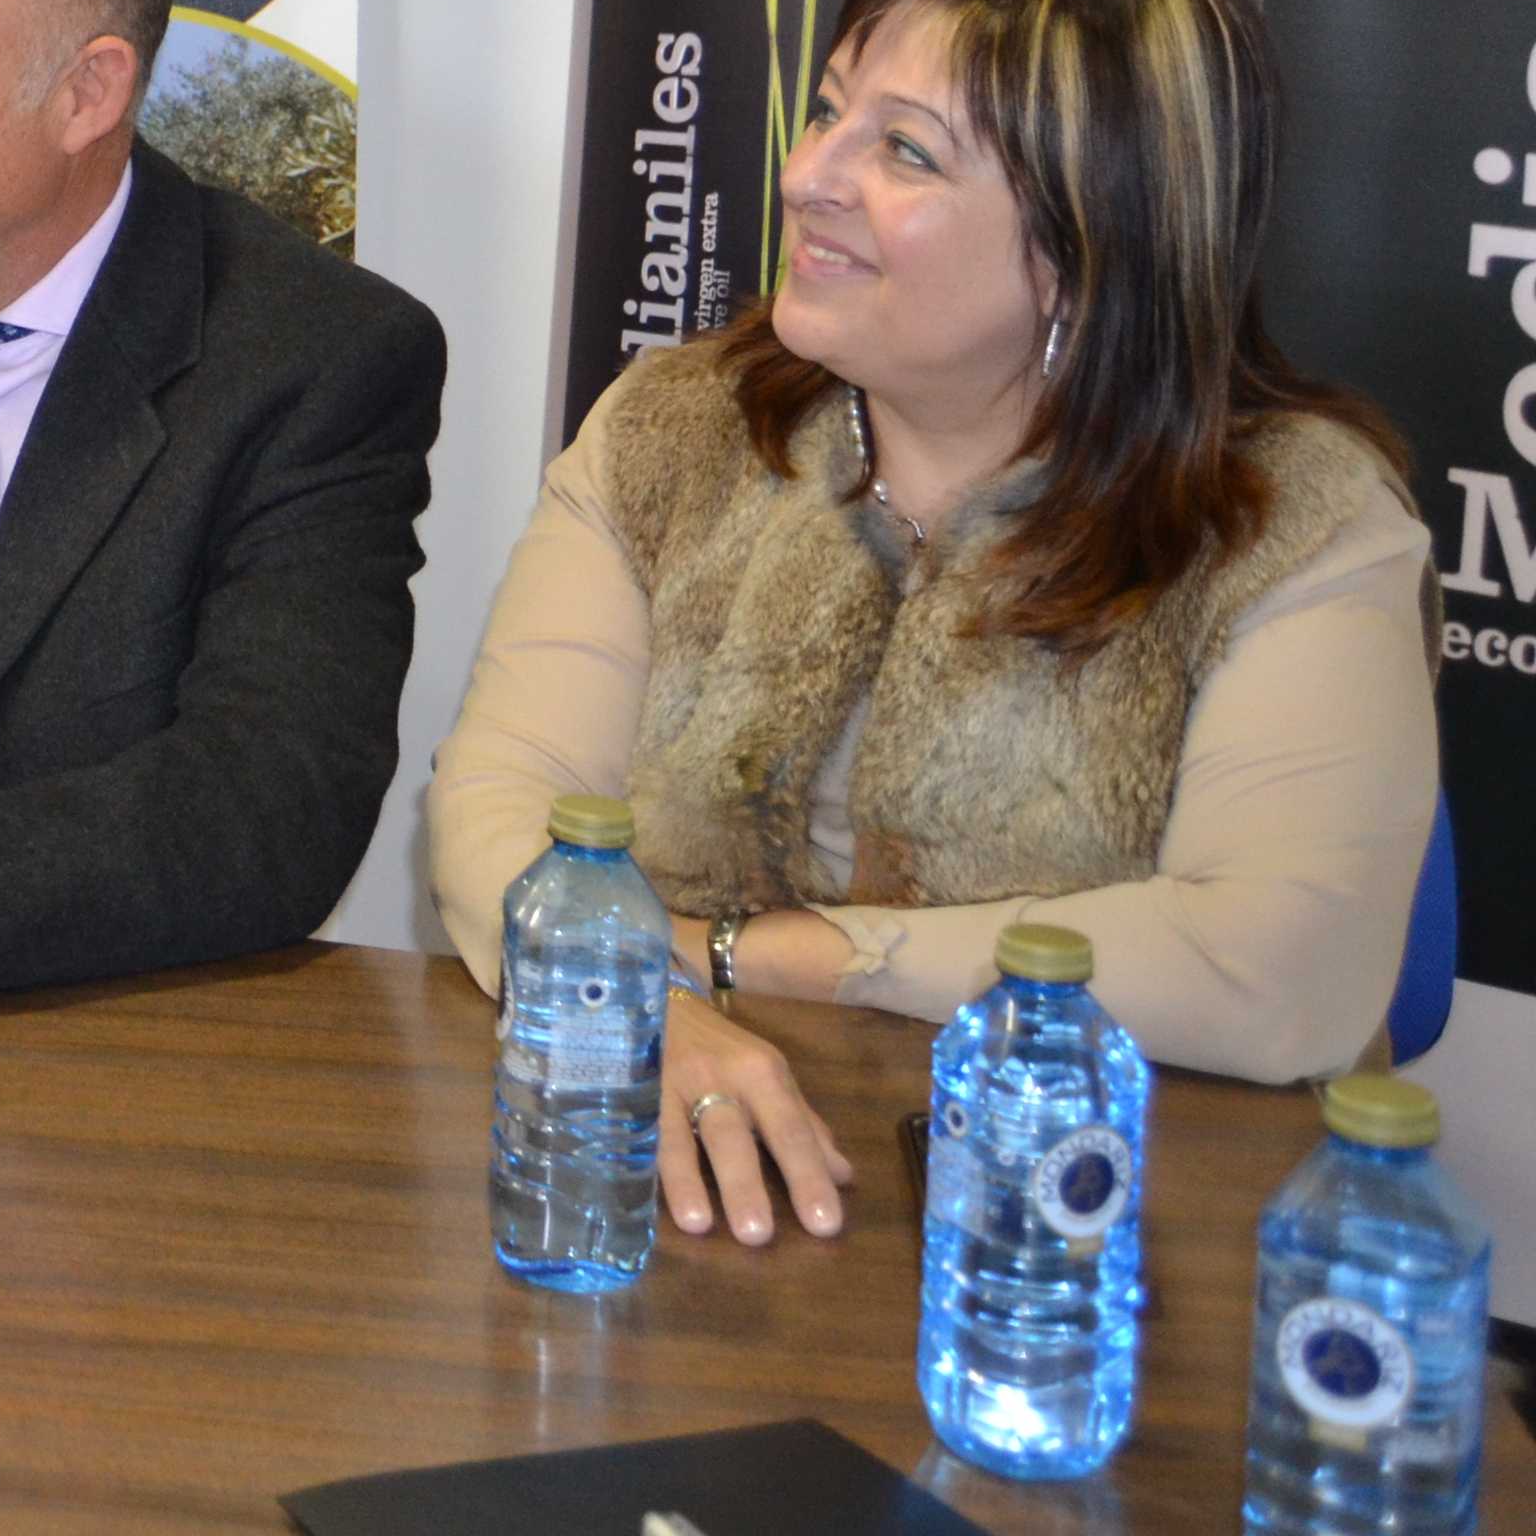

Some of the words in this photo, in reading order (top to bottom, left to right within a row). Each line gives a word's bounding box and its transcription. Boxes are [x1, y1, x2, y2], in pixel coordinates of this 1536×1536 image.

[701, 191, 719, 252] extra
[695, 259, 718, 332] virgen
[713, 270, 731, 298] oil
